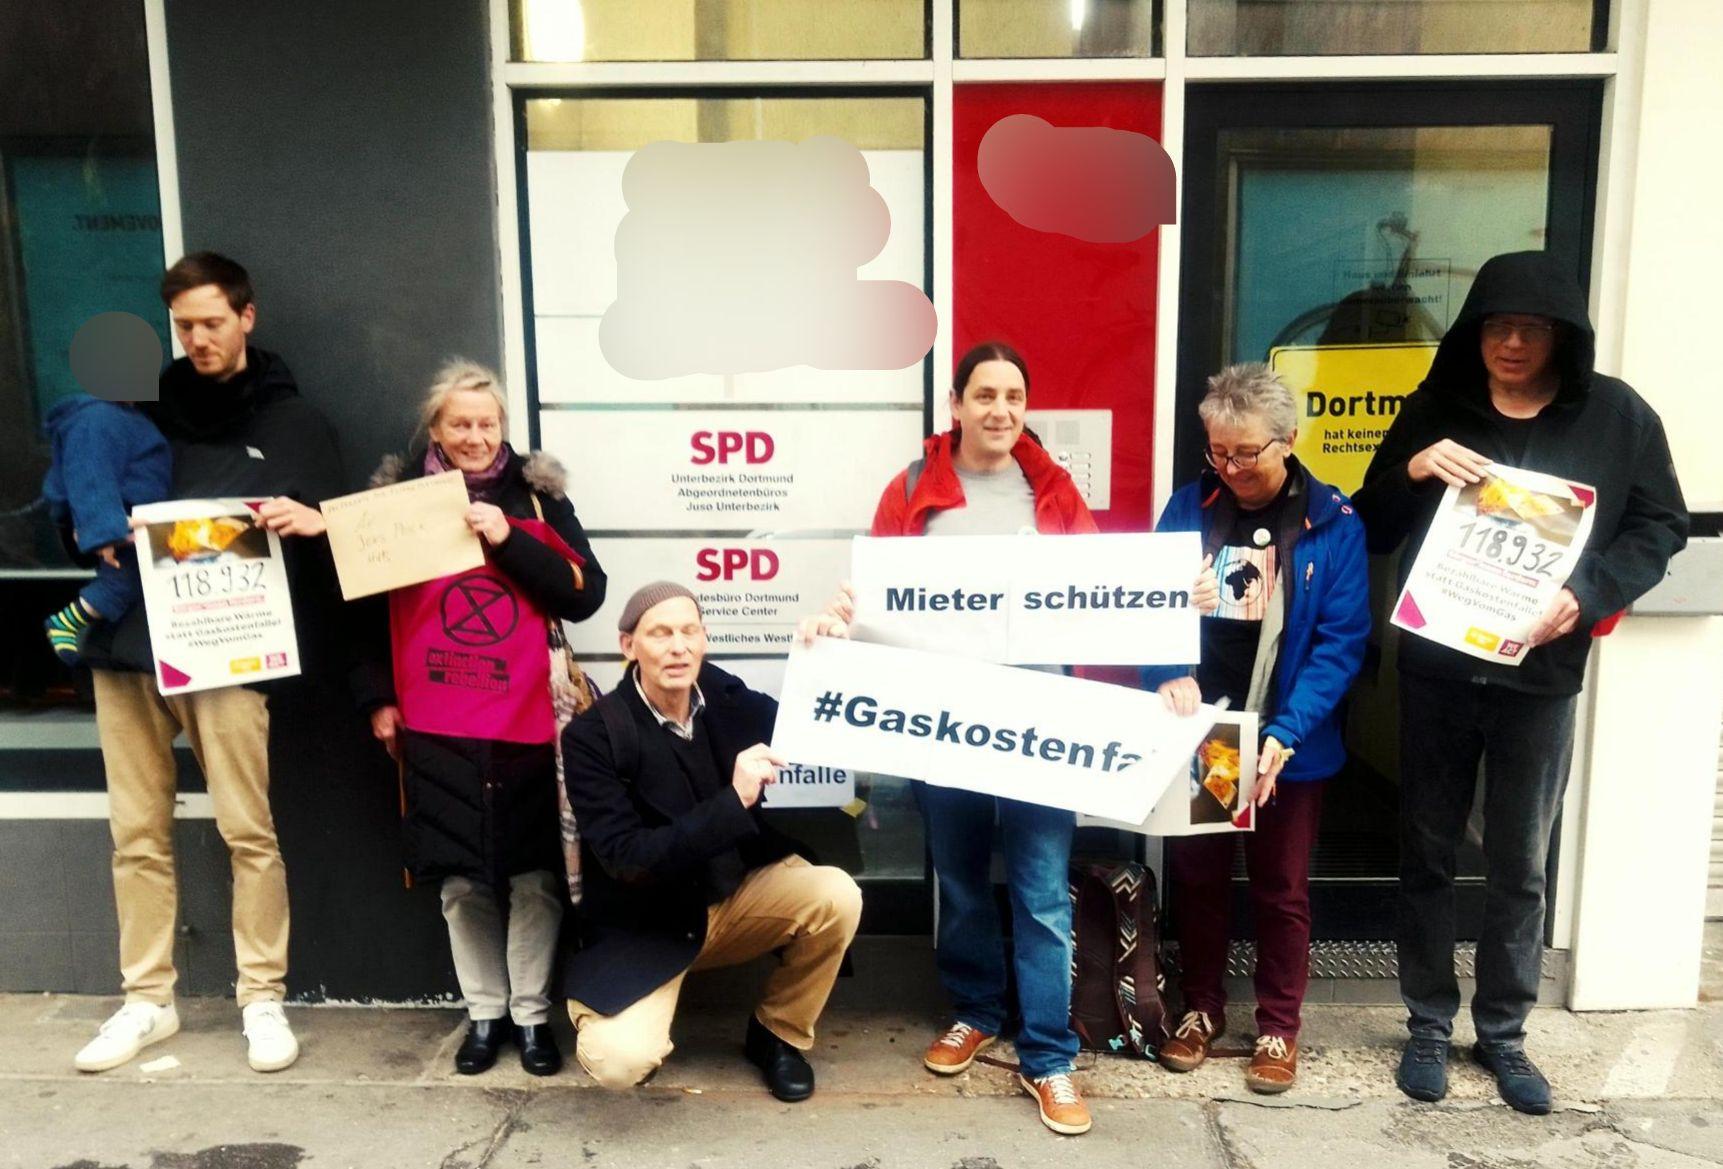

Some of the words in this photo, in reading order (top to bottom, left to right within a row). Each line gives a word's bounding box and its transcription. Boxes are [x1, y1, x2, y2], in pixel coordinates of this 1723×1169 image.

[1306, 391, 1407, 417] Dortm
[1324, 429, 1344, 440] hat
[690, 430, 775, 465] SPD
[671, 473, 735, 484] Unterbezirk
[738, 473, 794, 484] Dortmund
[677, 487, 788, 499] Abgeordnetenbüros
[686, 501, 713, 511] Juso
[716, 501, 780, 512] Unterbezirk
[1459, 521, 1564, 578] 118.932
[695, 547, 780, 582] SPD
[745, 592, 799, 603] Dortmund
[886, 587, 1004, 611] Mieter
[1023, 585, 1190, 610] schützen
[1440, 588, 1518, 623] #WegVomGas
[700, 606, 738, 617] Service
[742, 606, 778, 617] Center
[779, 763, 847, 784] nfalle
